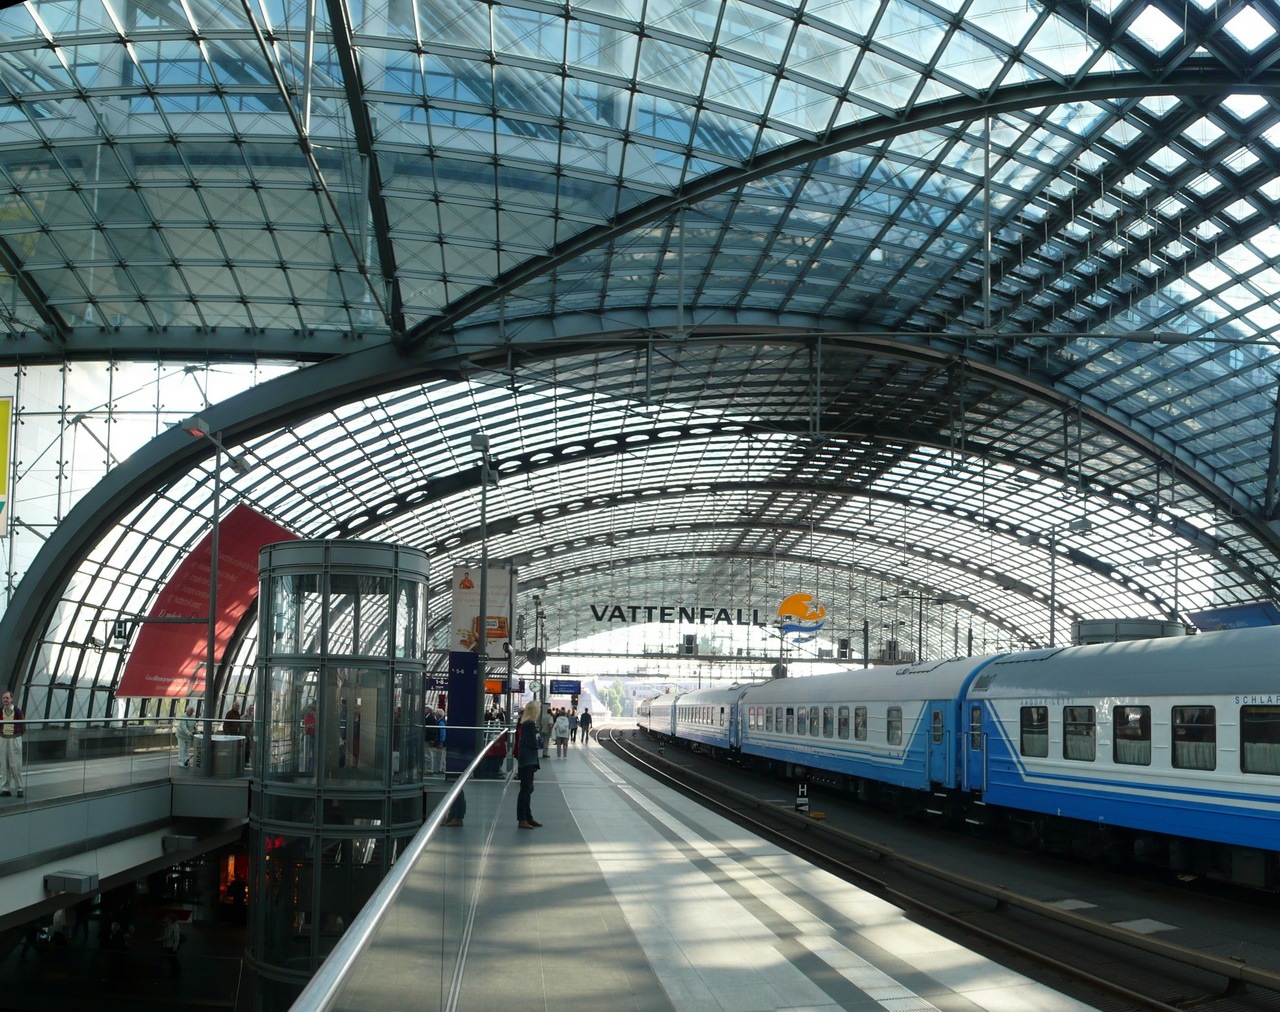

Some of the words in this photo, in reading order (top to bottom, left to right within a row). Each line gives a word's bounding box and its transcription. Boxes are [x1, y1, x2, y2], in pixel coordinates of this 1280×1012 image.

[590, 604, 766, 627] VATTENFALL
[115, 622, 125, 637] H
[799, 784, 808, 795] H
